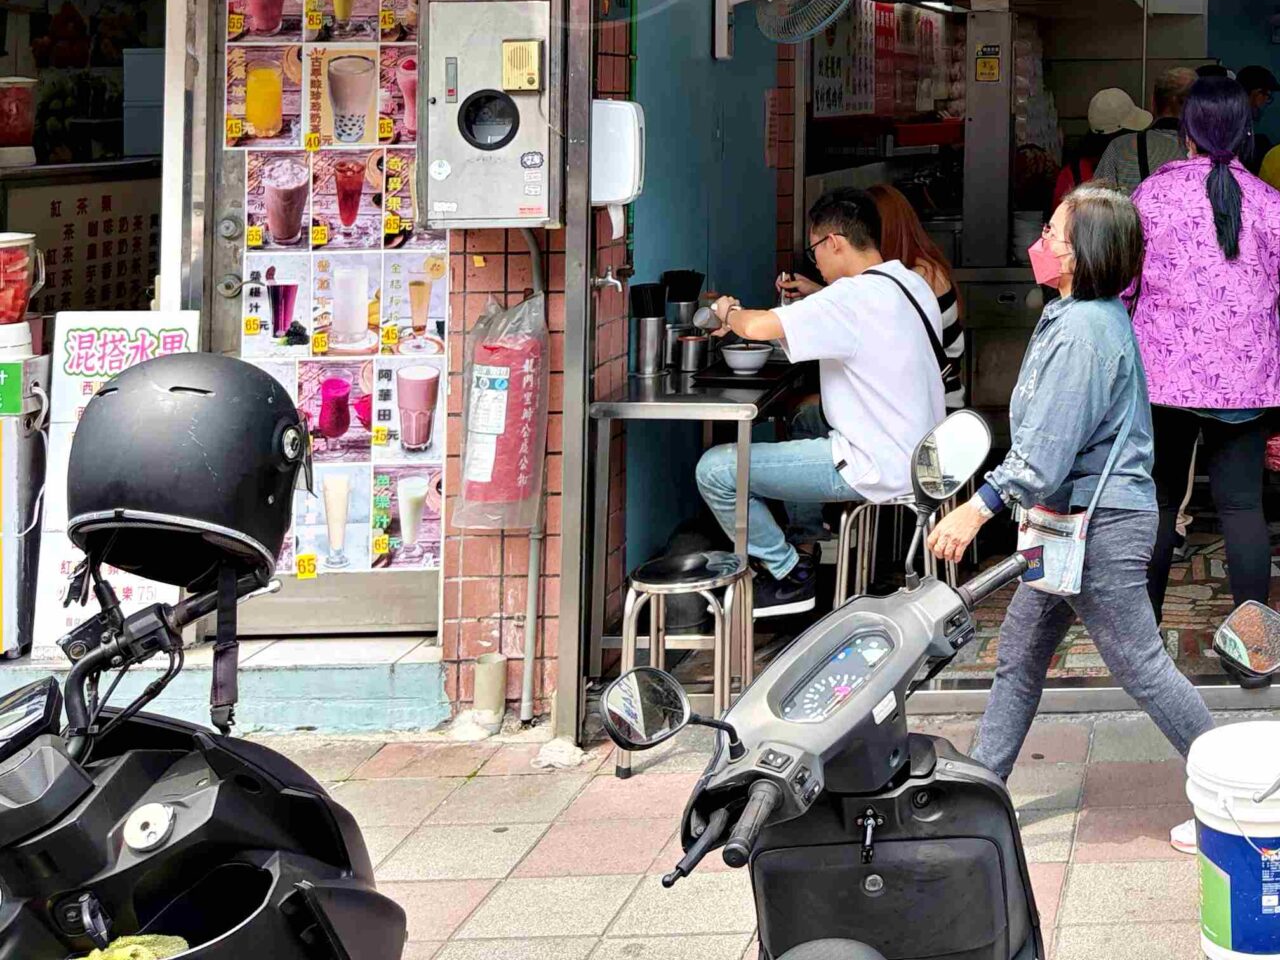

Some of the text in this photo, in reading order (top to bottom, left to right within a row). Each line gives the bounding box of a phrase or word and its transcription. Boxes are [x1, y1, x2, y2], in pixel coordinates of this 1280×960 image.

[378, 369, 392, 422] 阿華田
[298, 558, 317, 574] 65
